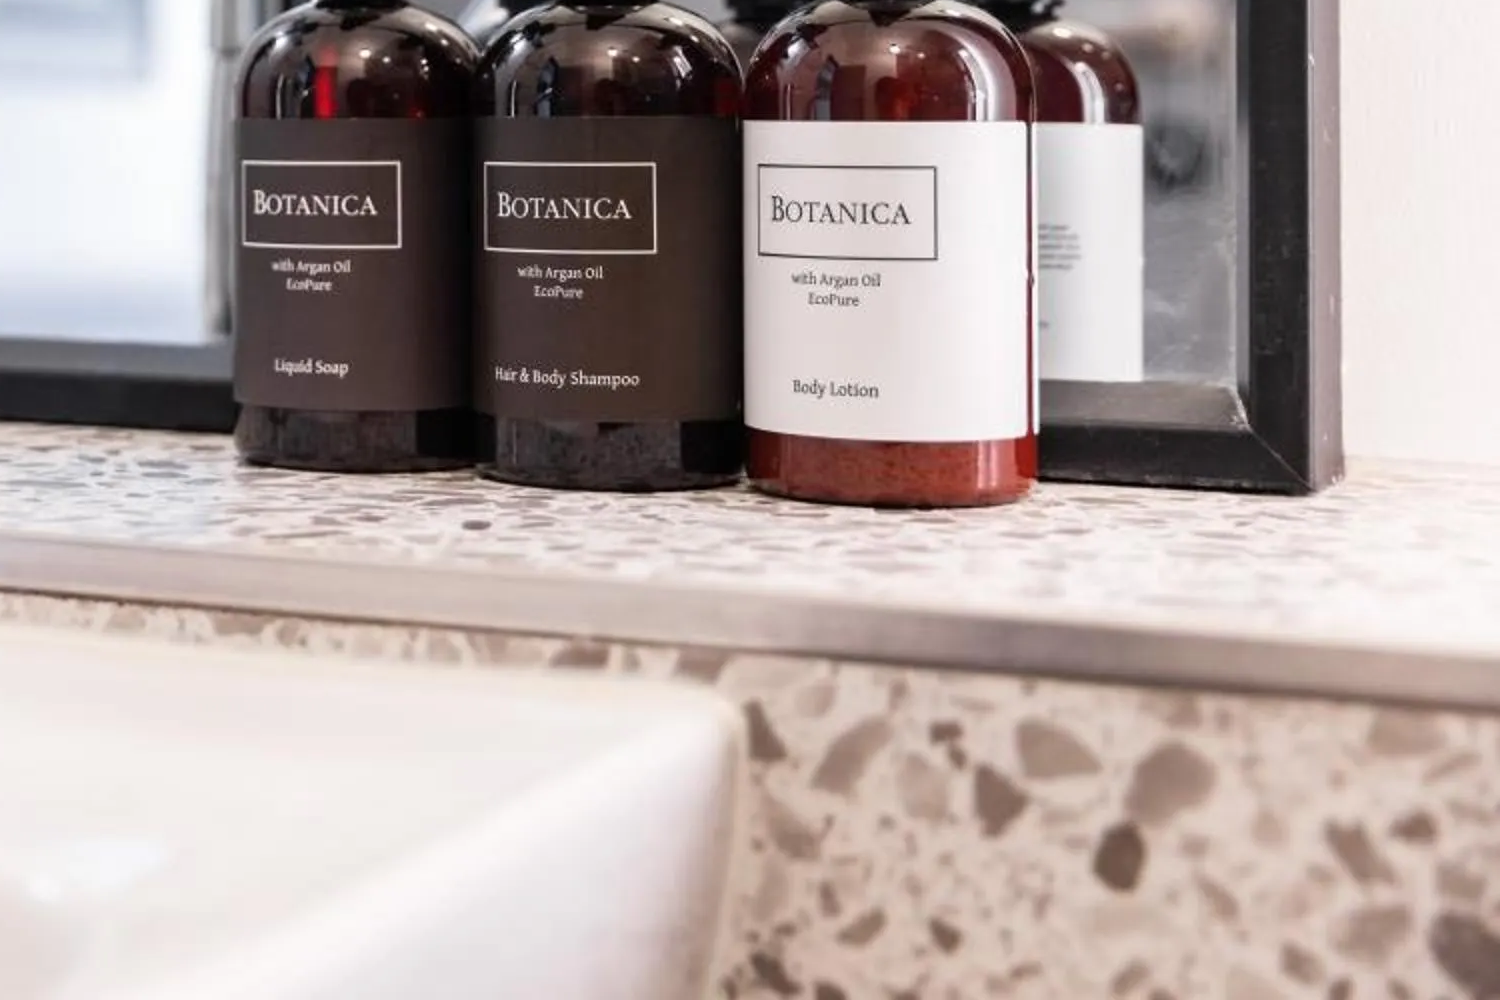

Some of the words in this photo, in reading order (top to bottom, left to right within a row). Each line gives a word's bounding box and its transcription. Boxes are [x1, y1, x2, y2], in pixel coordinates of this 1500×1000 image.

[252, 189, 378, 217] BOTANICA
[496, 191, 632, 220] BOTANICA
[771, 196, 912, 226] BOTANICA
[271, 258, 294, 273] with
[296, 260, 330, 275] Argan
[333, 260, 351, 273] Oil
[517, 264, 542, 279] with
[545, 266, 582, 282] Argan
[585, 266, 604, 280] Oil
[286, 278, 332, 292] EcoPure
[791, 271, 817, 287] with
[819, 272, 858, 290] Argan
[861, 273, 881, 288] Oil
[533, 285, 584, 299] EcoPure
[808, 292, 860, 308] EcoPure
[274, 358, 313, 376] Liquid
[315, 360, 349, 378] Soap
[495, 366, 518, 382] Hair
[519, 369, 530, 384] &
[533, 368, 566, 390] Body
[570, 369, 641, 391] Shampoo
[792, 379, 826, 399] Body
[830, 380, 879, 400] Lotion
